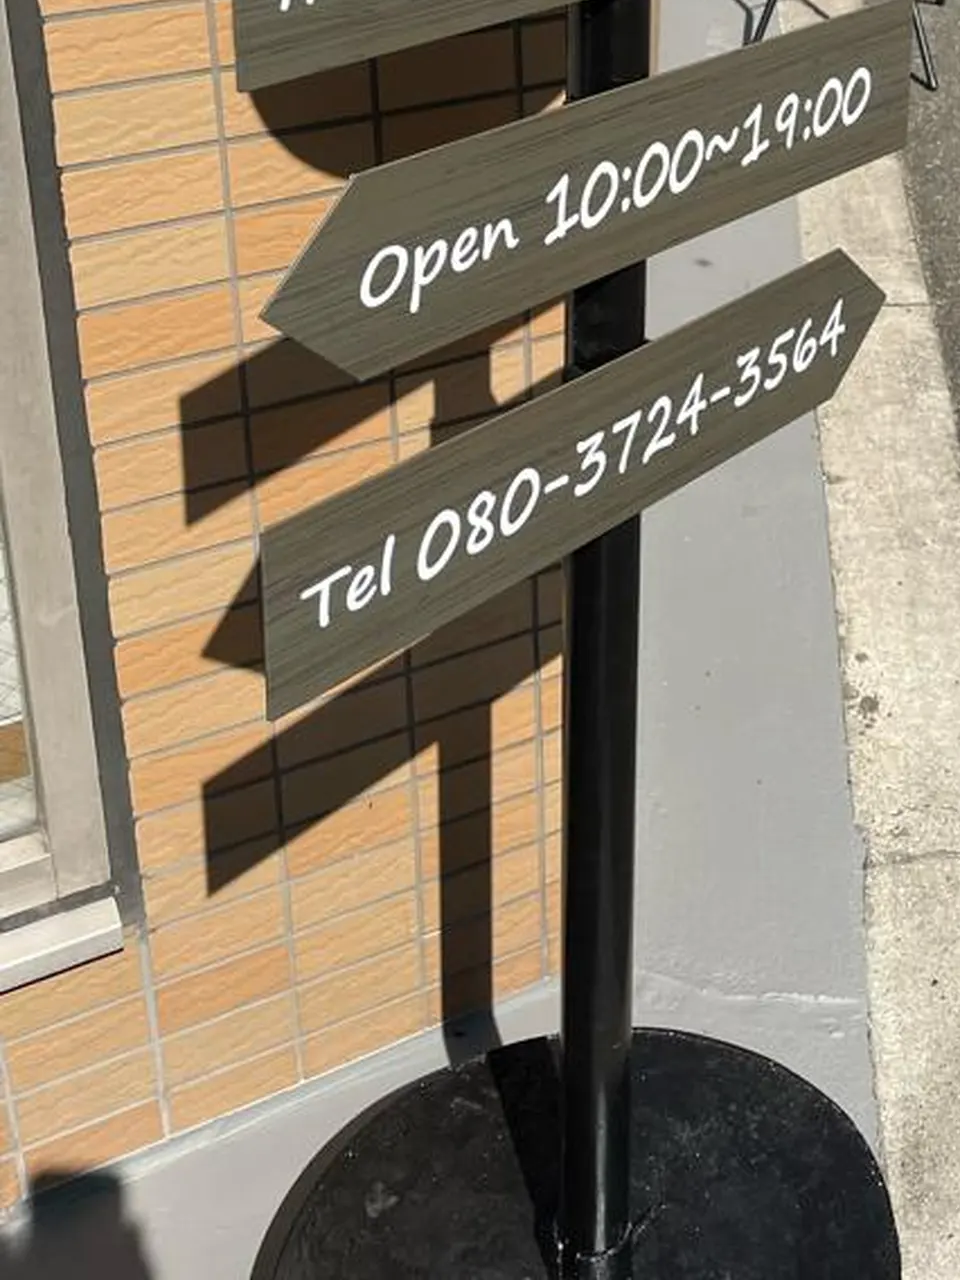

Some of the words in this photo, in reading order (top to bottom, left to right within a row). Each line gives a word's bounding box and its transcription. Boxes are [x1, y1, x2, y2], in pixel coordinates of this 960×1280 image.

[359, 218, 519, 314] Open
[543, 67, 871, 246] 10:00~19:00
[300, 534, 395, 628] Tel
[416, 299, 847, 581] 080-3724-3564
